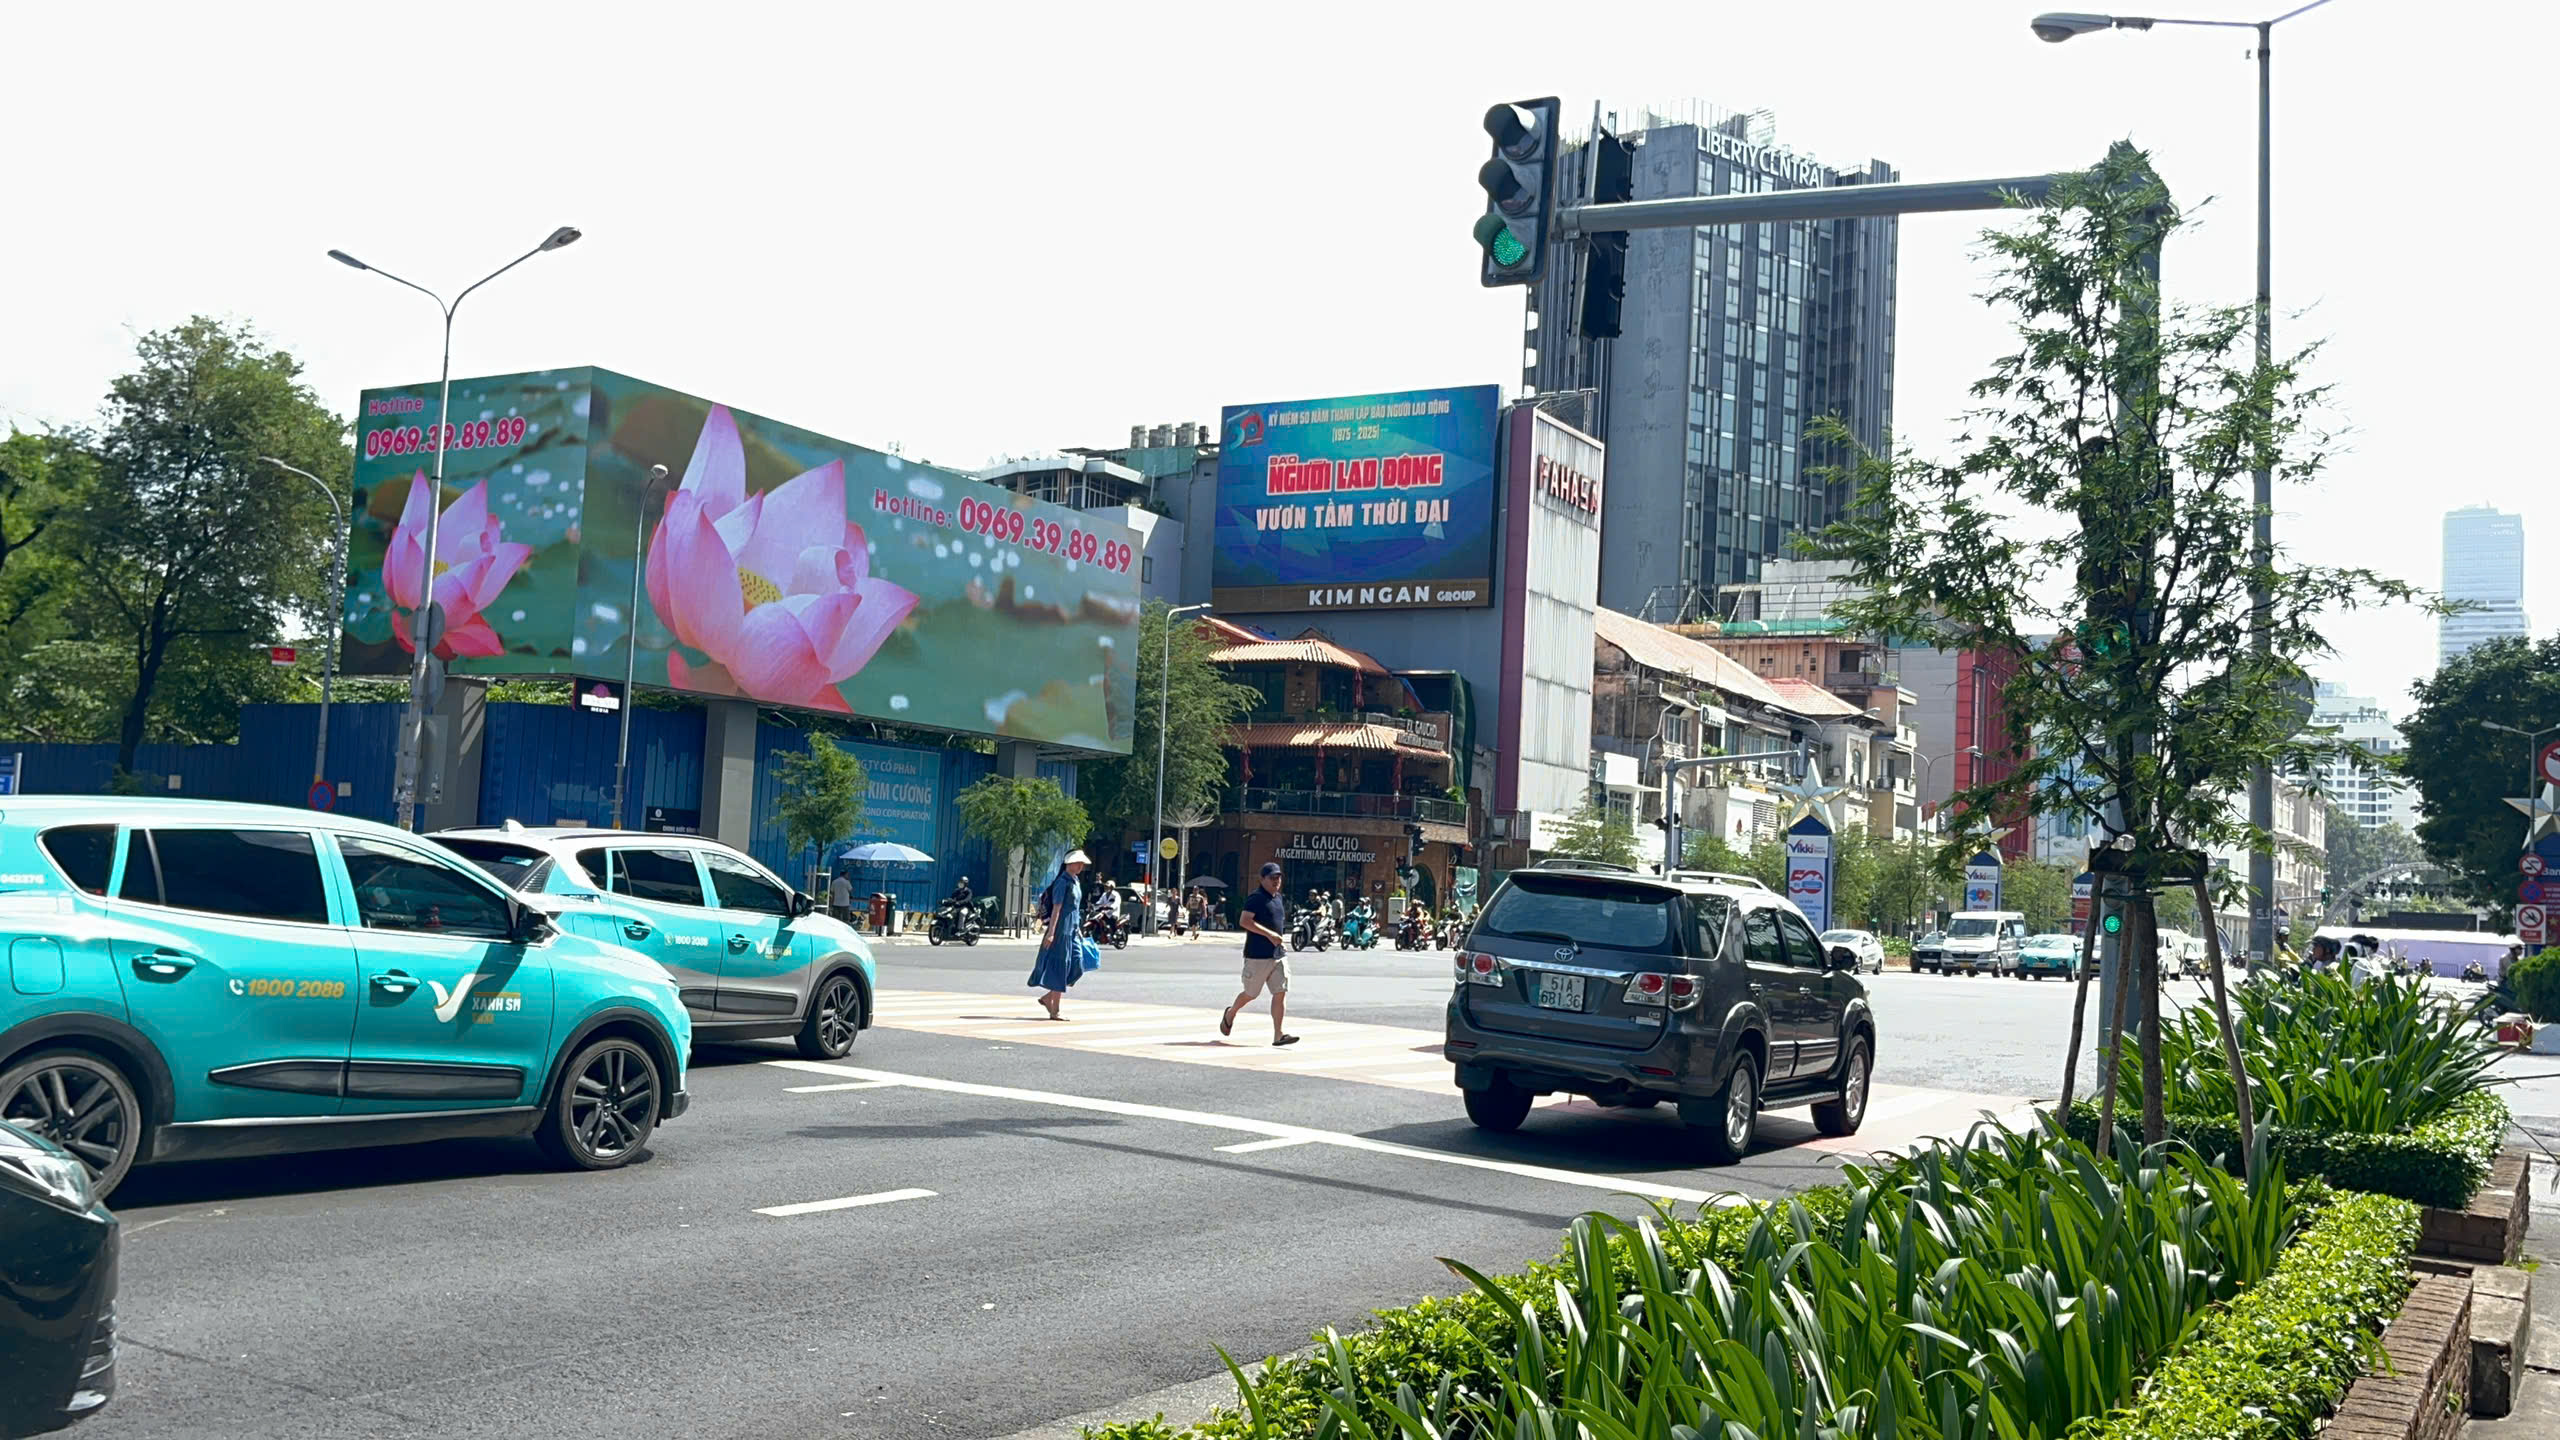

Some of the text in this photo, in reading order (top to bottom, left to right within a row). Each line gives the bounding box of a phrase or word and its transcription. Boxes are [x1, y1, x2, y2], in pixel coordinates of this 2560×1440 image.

[1698, 127, 1762, 167] LIBERTY
[368, 398, 424, 416] Hotline
[1300, 411, 1310, 424] 50
[1413, 401, 1426, 416] LAO
[366, 416, 526, 456] 0969.39.89.89
[1267, 453, 1443, 495] NGƯỜI LAO ĐỘNG
[1537, 455, 1599, 514] FAHASA
[1256, 504, 1306, 531] VƯƠN
[1361, 499, 1407, 525] THỜI
[1415, 499, 1449, 527] ĐẠI
[873, 488, 1132, 573] Hotline: 0969.39.89.89
[1309, 586, 1476, 605] KIM NGAN GROUP
[868, 781, 890, 801] KIM
[892, 782, 932, 804] CƯƠNG
[882, 809, 930, 820] CORPORATION
[1293, 834, 1359, 851] EL GAUCHO
[1789, 839, 1814, 854] Vikki
[1275, 848, 1376, 863] ARGENTINIAN STEAKHOUSE
[1967, 868, 1987, 880] Vikki
[248, 979, 345, 998] 1900 2088
[1551, 977, 1573, 992] 51A
[472, 997, 521, 1012] XANH SM
